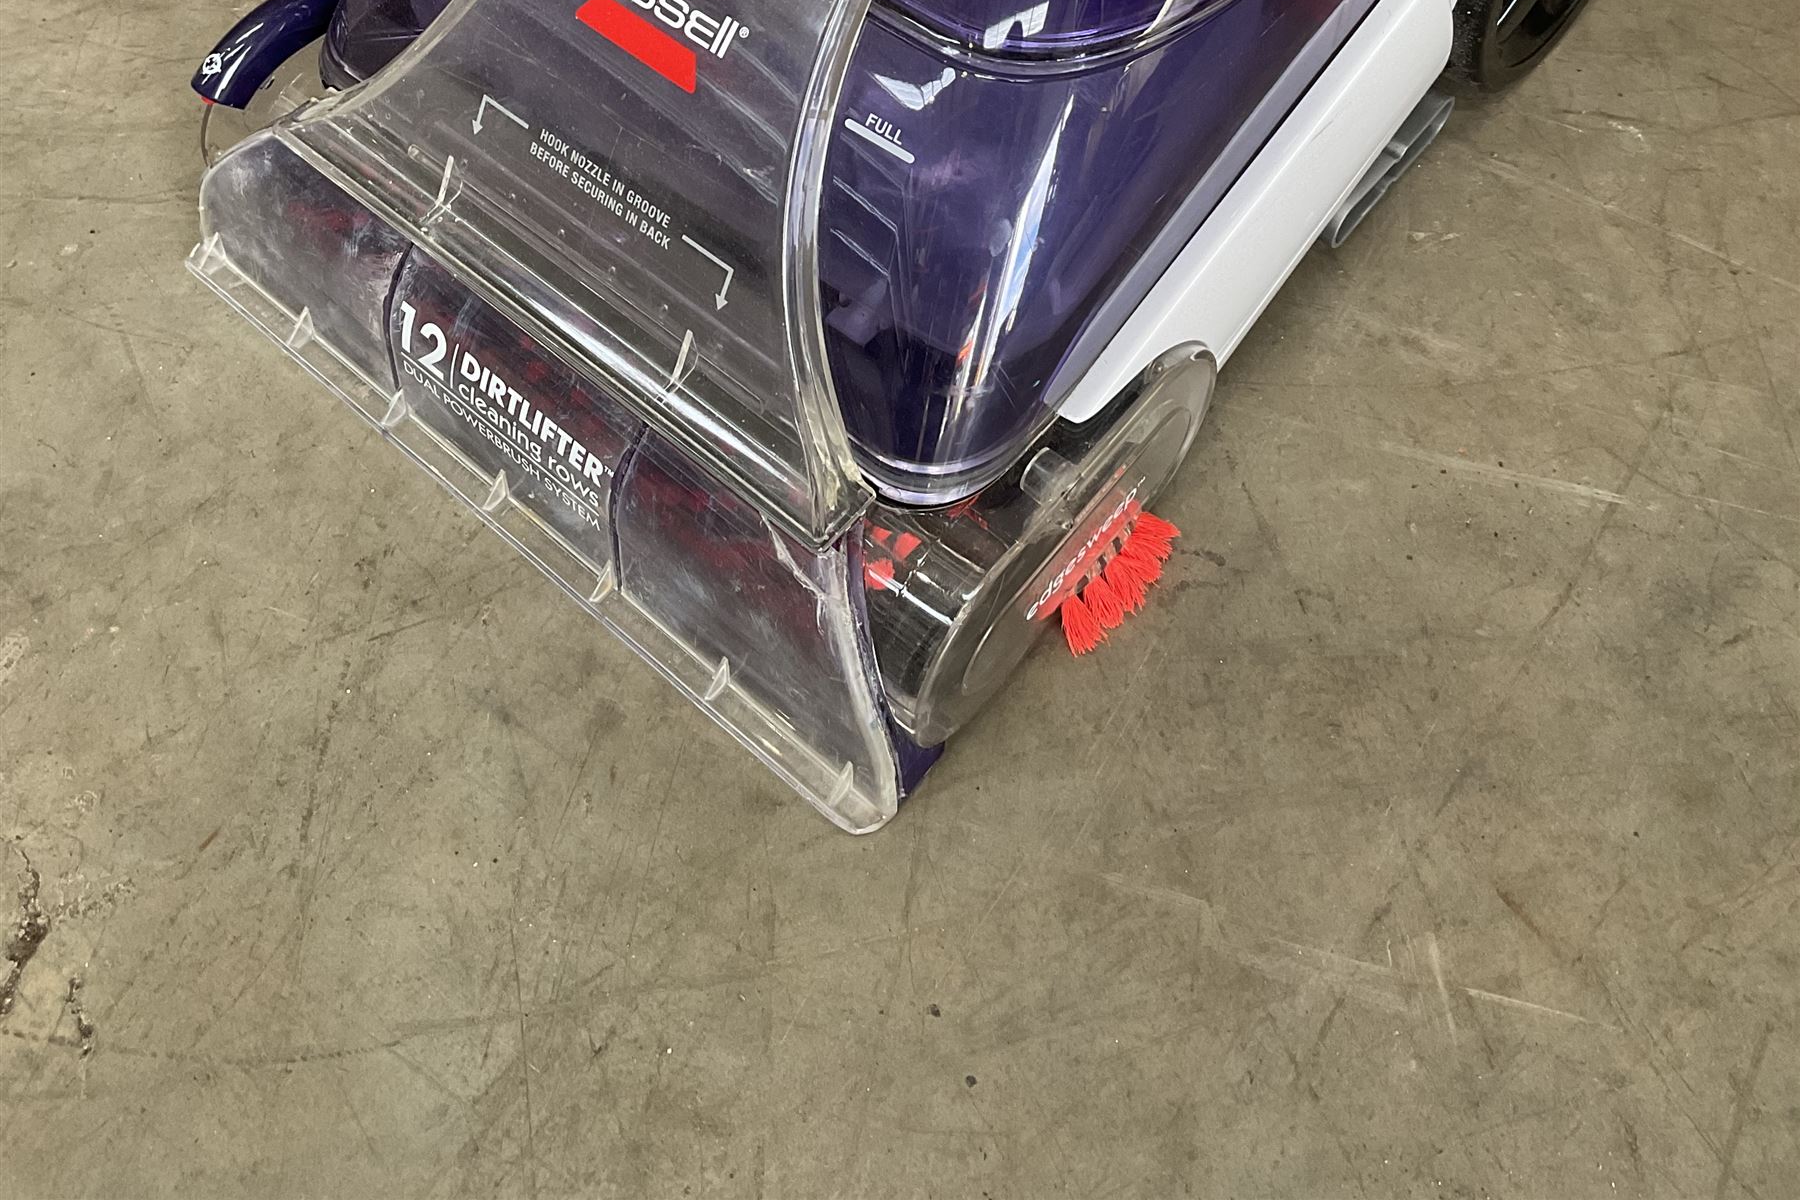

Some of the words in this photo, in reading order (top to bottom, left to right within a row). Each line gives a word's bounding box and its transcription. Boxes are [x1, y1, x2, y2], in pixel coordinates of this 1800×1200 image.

[539, 128, 570, 157] HOOK
[570, 149, 612, 187] NOZZLE
[611, 178, 626, 196] IN
[626, 189, 671, 228] GROOVE
[865, 112, 903, 146] FULL
[529, 141, 571, 178] BEFORE
[570, 171, 624, 217] SECURING
[625, 209, 640, 228] IN
[639, 219, 671, 250] BACK
[399, 300, 448, 382] 12
[403, 360, 442, 399] DUAL
[443, 393, 542, 481] POWERBRUSH
[544, 476, 601, 532] SYSTEM
[457, 382, 543, 463] cleaning
[547, 457, 600, 508] rows
